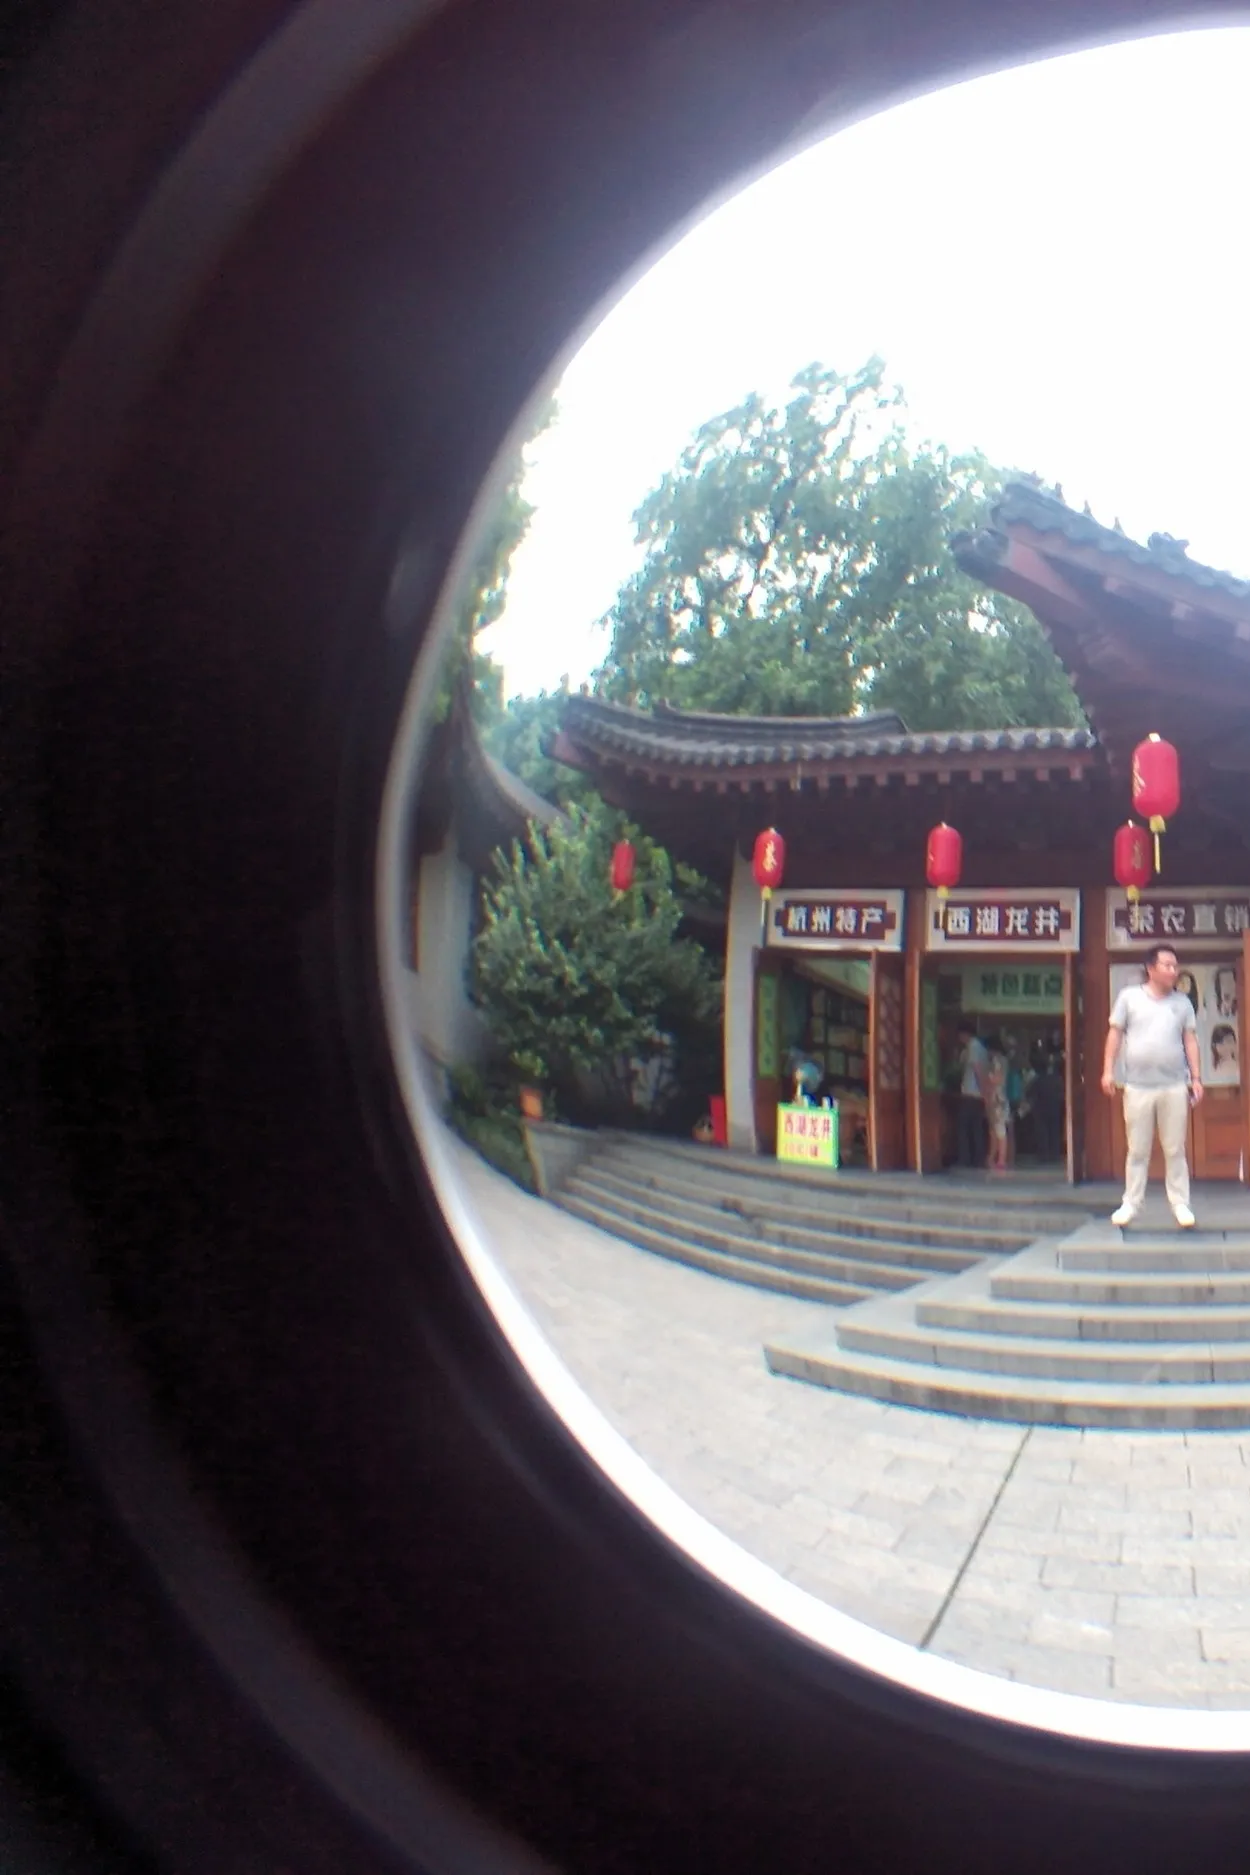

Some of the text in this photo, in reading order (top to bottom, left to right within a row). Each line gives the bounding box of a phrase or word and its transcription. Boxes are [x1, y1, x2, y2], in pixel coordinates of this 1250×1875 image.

[787, 905, 884, 934] 杭州特产
[946, 906, 1059, 936] 西湖龙井
